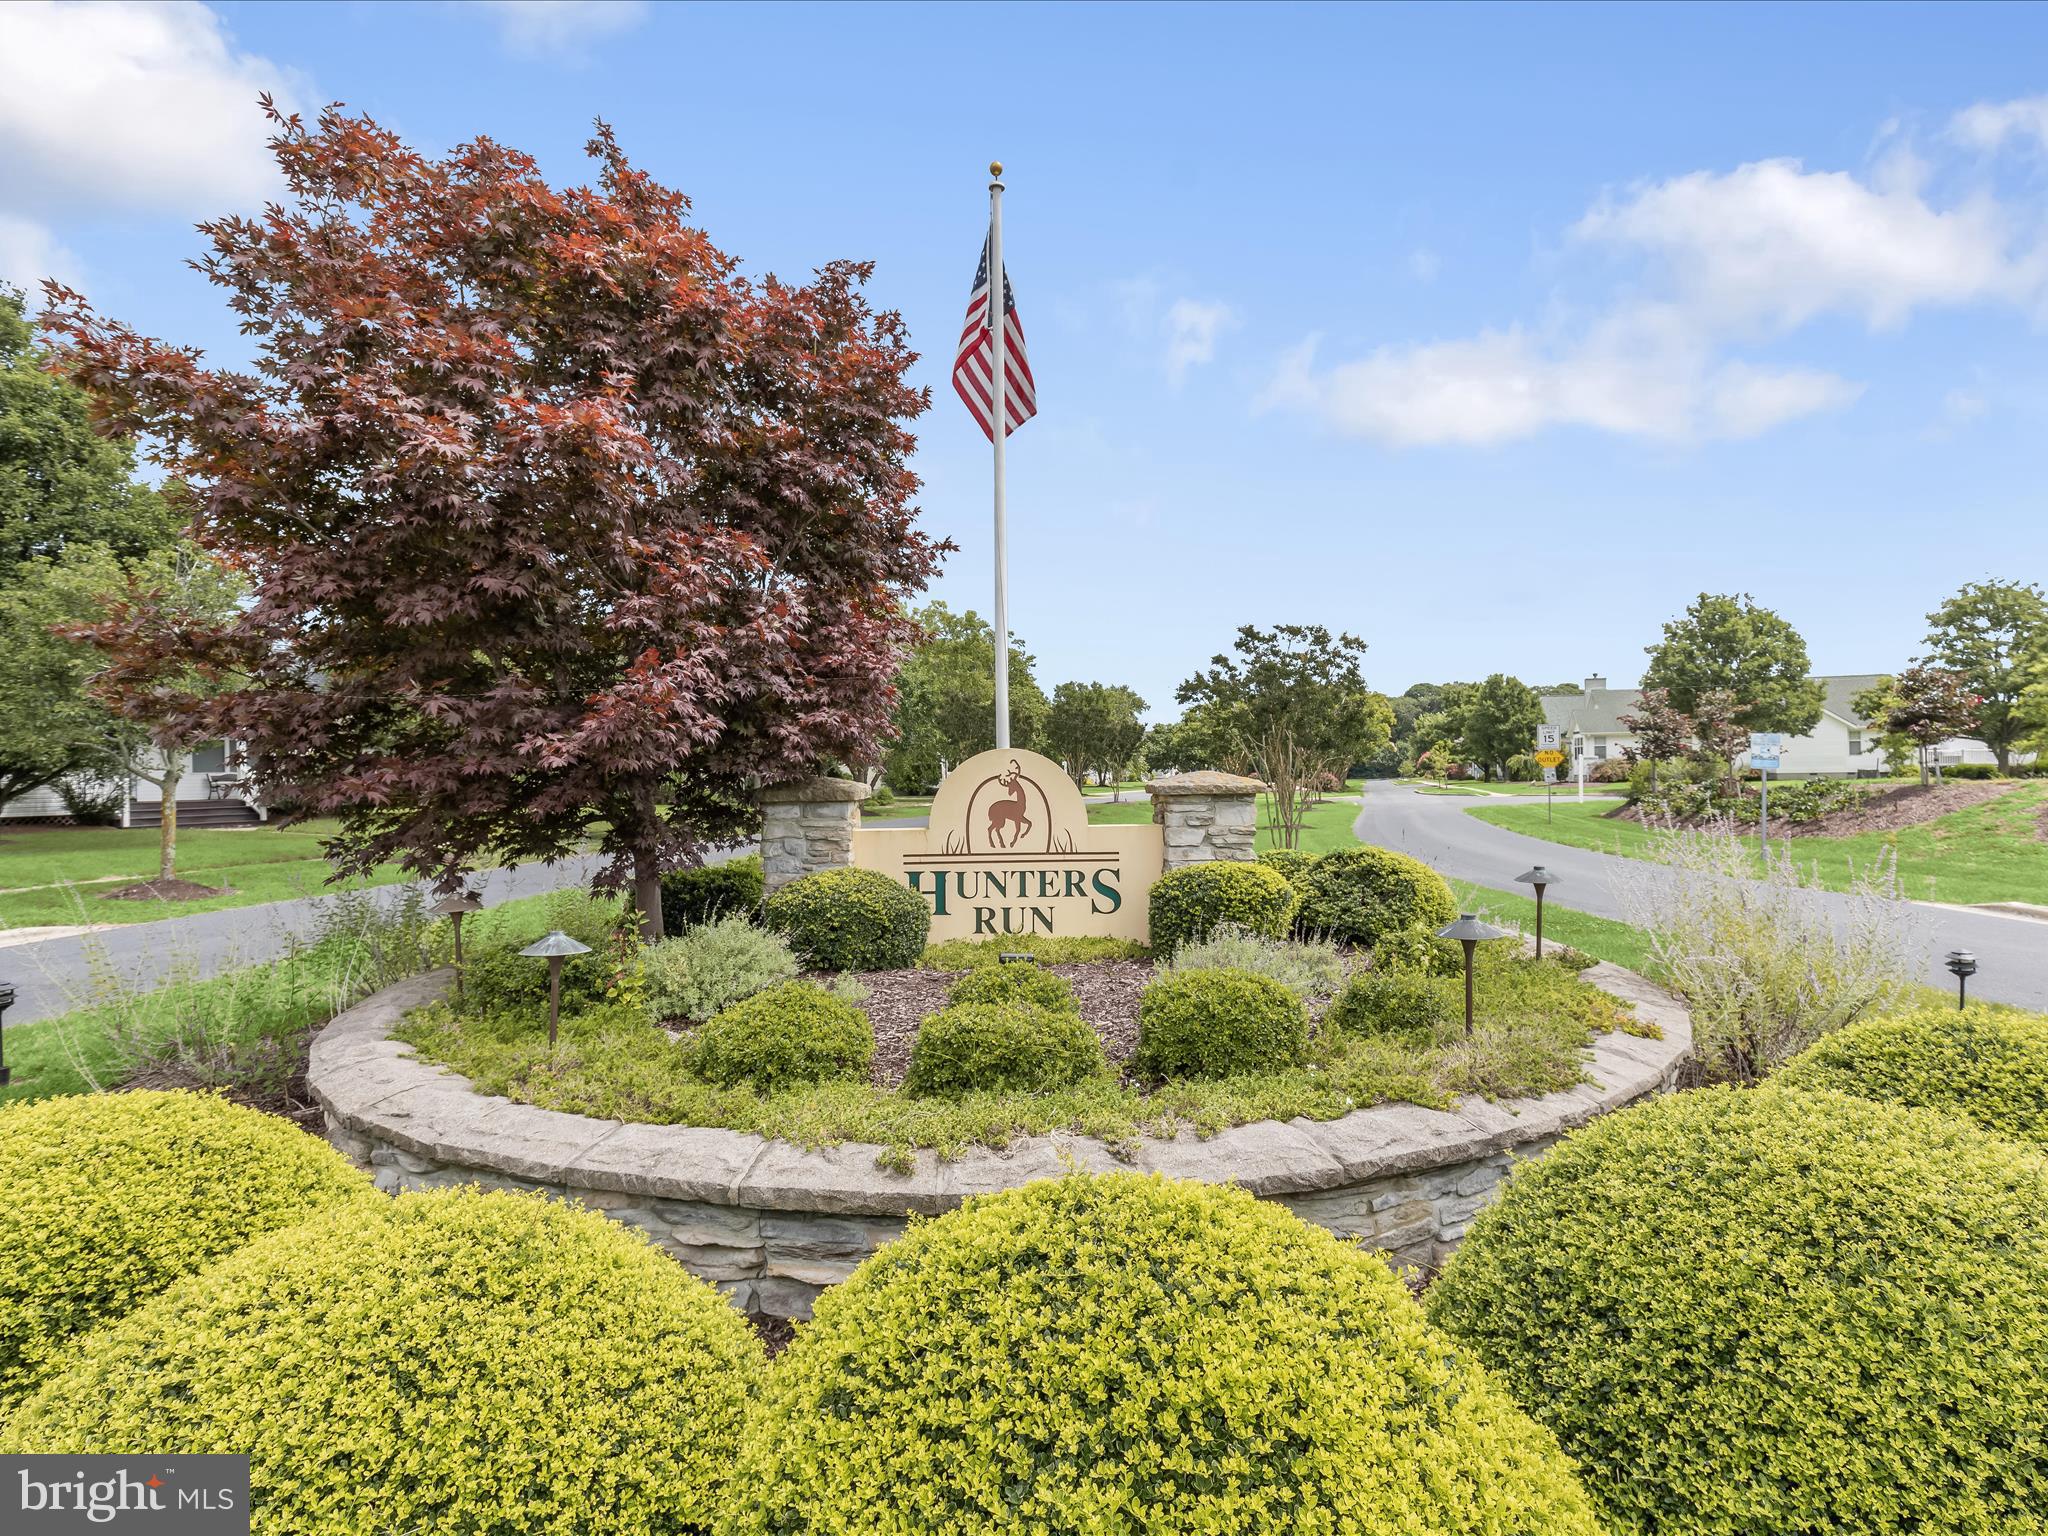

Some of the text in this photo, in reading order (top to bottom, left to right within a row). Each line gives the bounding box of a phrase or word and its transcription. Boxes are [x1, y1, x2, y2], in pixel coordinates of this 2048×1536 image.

[1543, 735, 1555, 743] 15
[904, 868, 1122, 915] HUNTERS
[972, 906, 1056, 935] RUN
